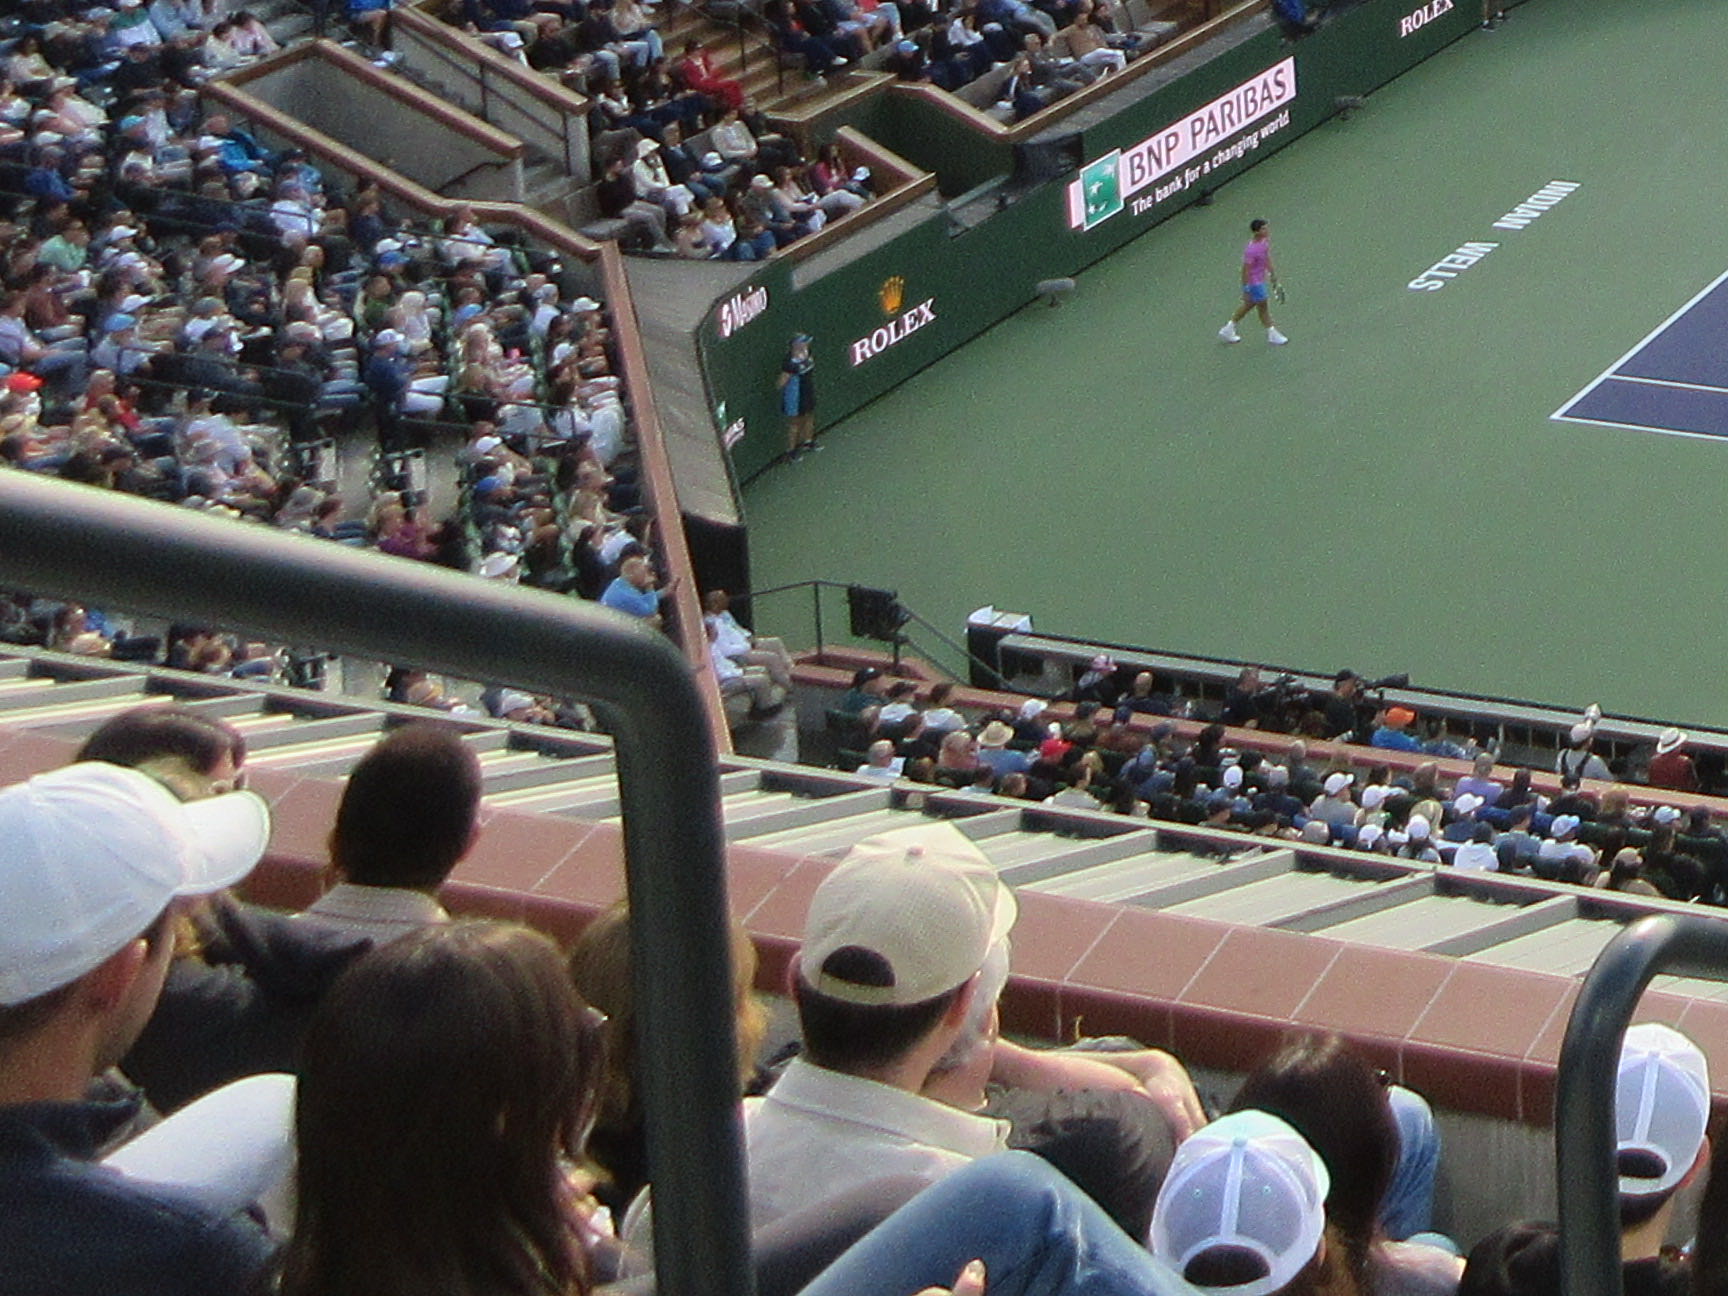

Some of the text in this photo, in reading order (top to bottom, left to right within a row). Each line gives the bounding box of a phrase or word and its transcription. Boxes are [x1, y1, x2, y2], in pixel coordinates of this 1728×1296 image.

[1129, 67, 1287, 187] BNP PARIBAS
[1131, 109, 1290, 216] The bank for a changing world
[1406, 179, 1583, 292] INDIAN WELLS
[852, 297, 938, 368] ROLEX
